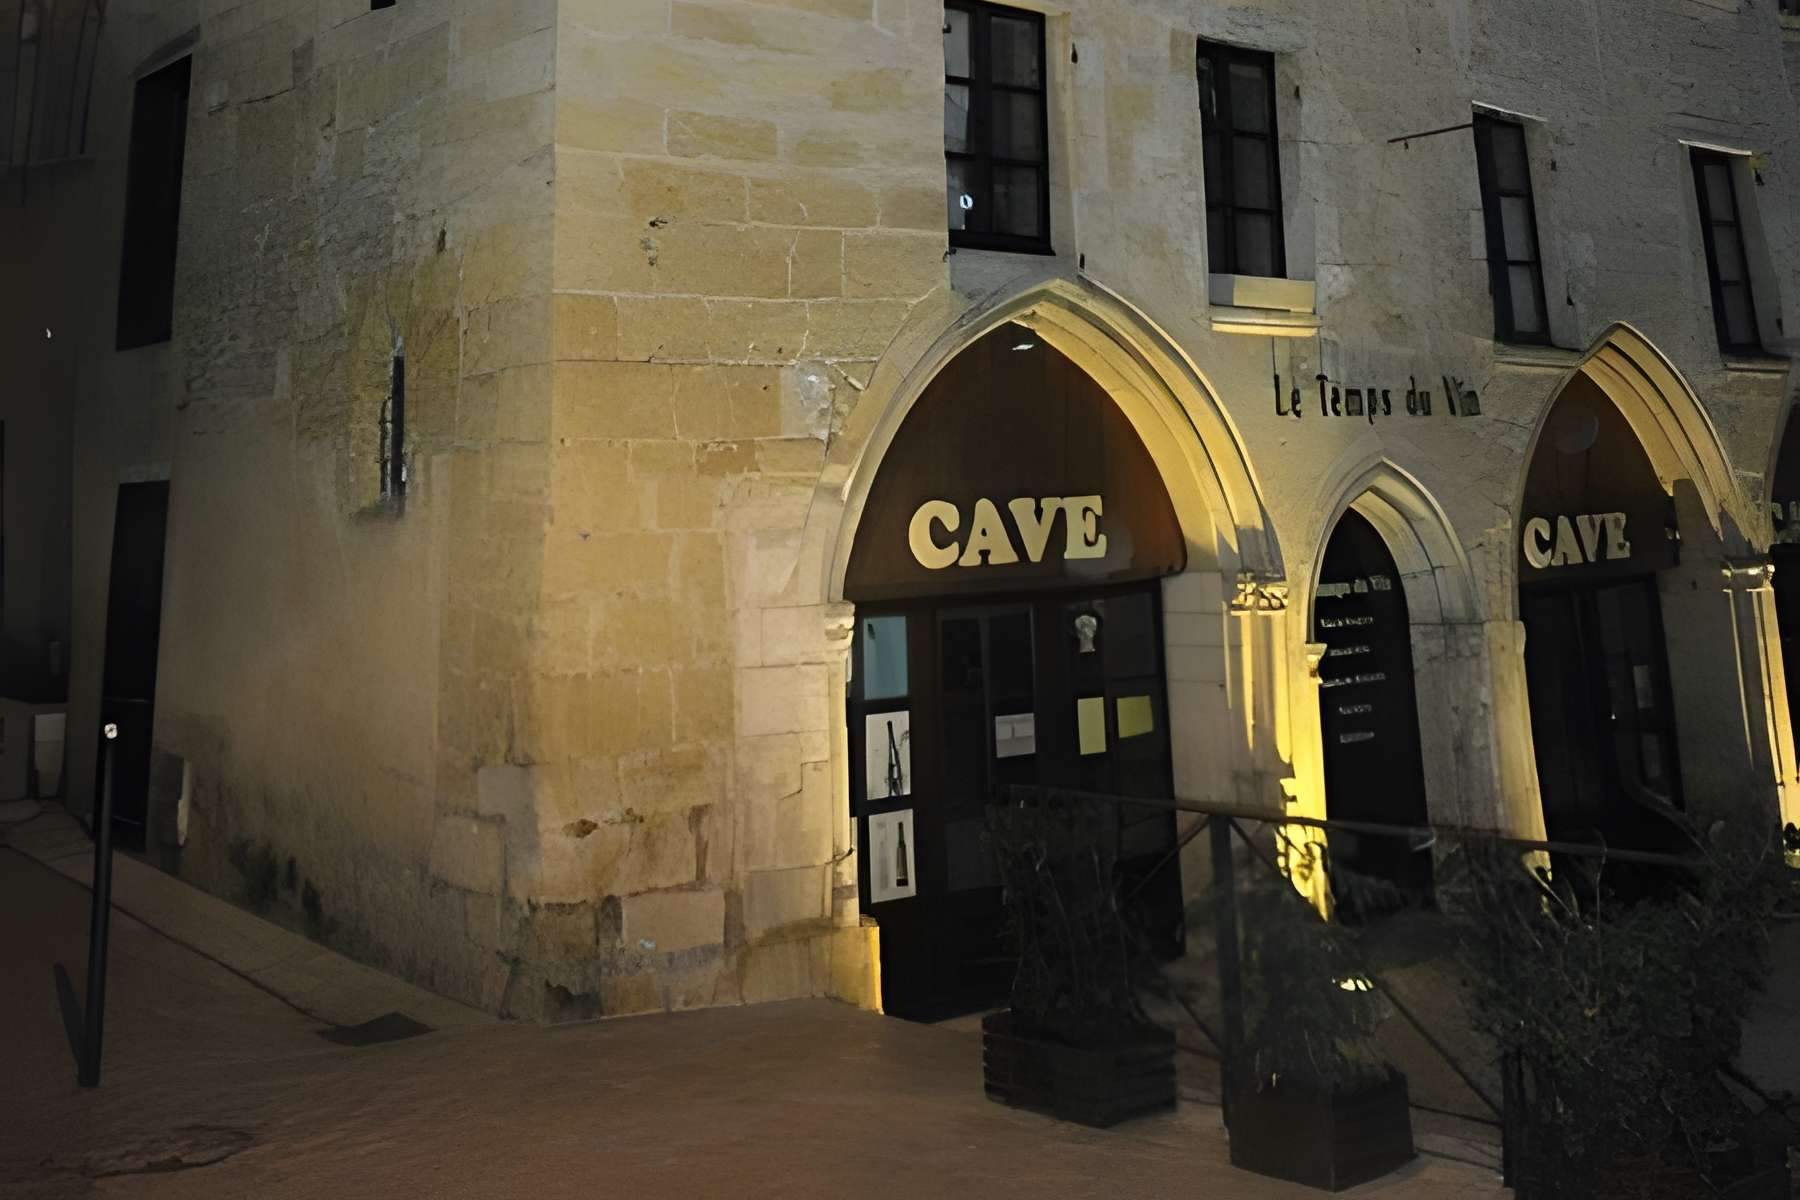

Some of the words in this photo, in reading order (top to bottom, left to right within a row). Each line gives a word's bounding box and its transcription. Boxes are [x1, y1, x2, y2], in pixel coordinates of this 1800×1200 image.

[1274, 374, 1301, 418] Le
[908, 495, 1107, 569] CAVE
[1523, 512, 1631, 569] CAVE
